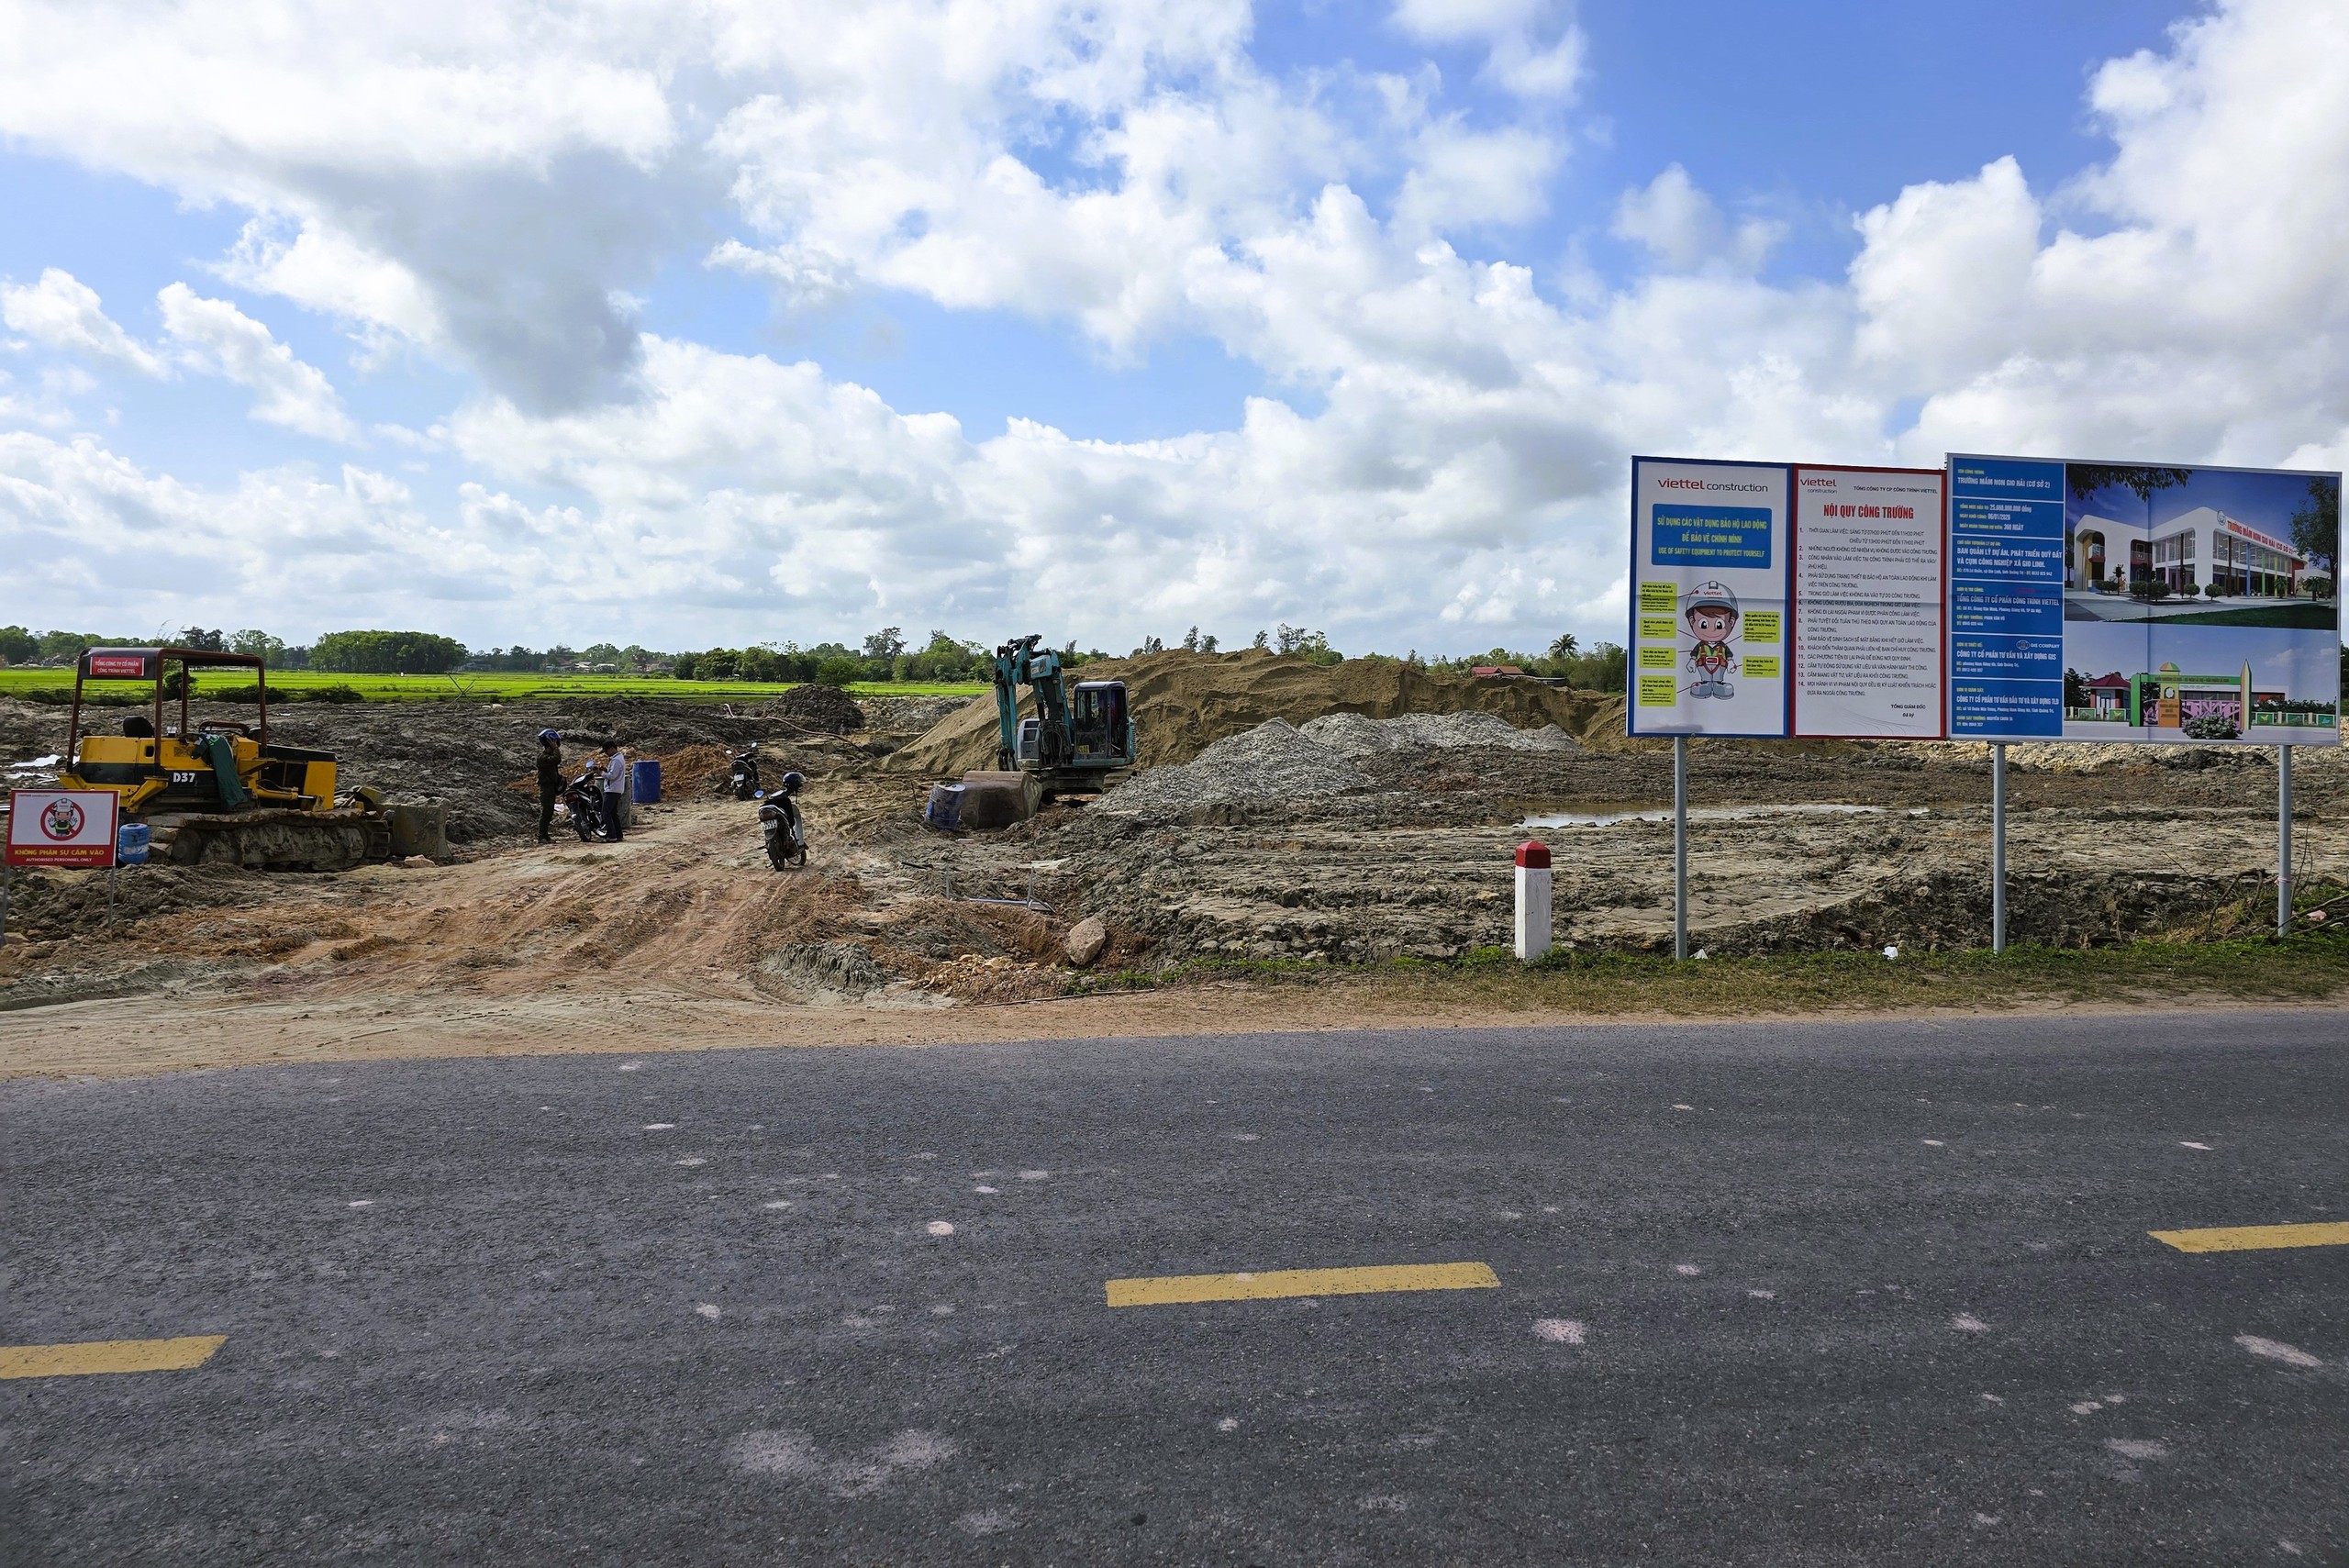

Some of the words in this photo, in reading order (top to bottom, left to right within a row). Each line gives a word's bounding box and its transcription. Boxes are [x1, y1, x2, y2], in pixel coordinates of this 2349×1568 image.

[1658, 478, 1704, 489] viettel
[1707, 483, 1767, 492] construction
[1800, 478, 1837, 487] viettel
[1824, 503, 1837, 518] NỘI
[1841, 506, 1855, 518] QUY
[1858, 505, 1880, 518] CÔNG
[1882, 506, 1913, 519] TRƯỜNG
[173, 773, 195, 783] D37
